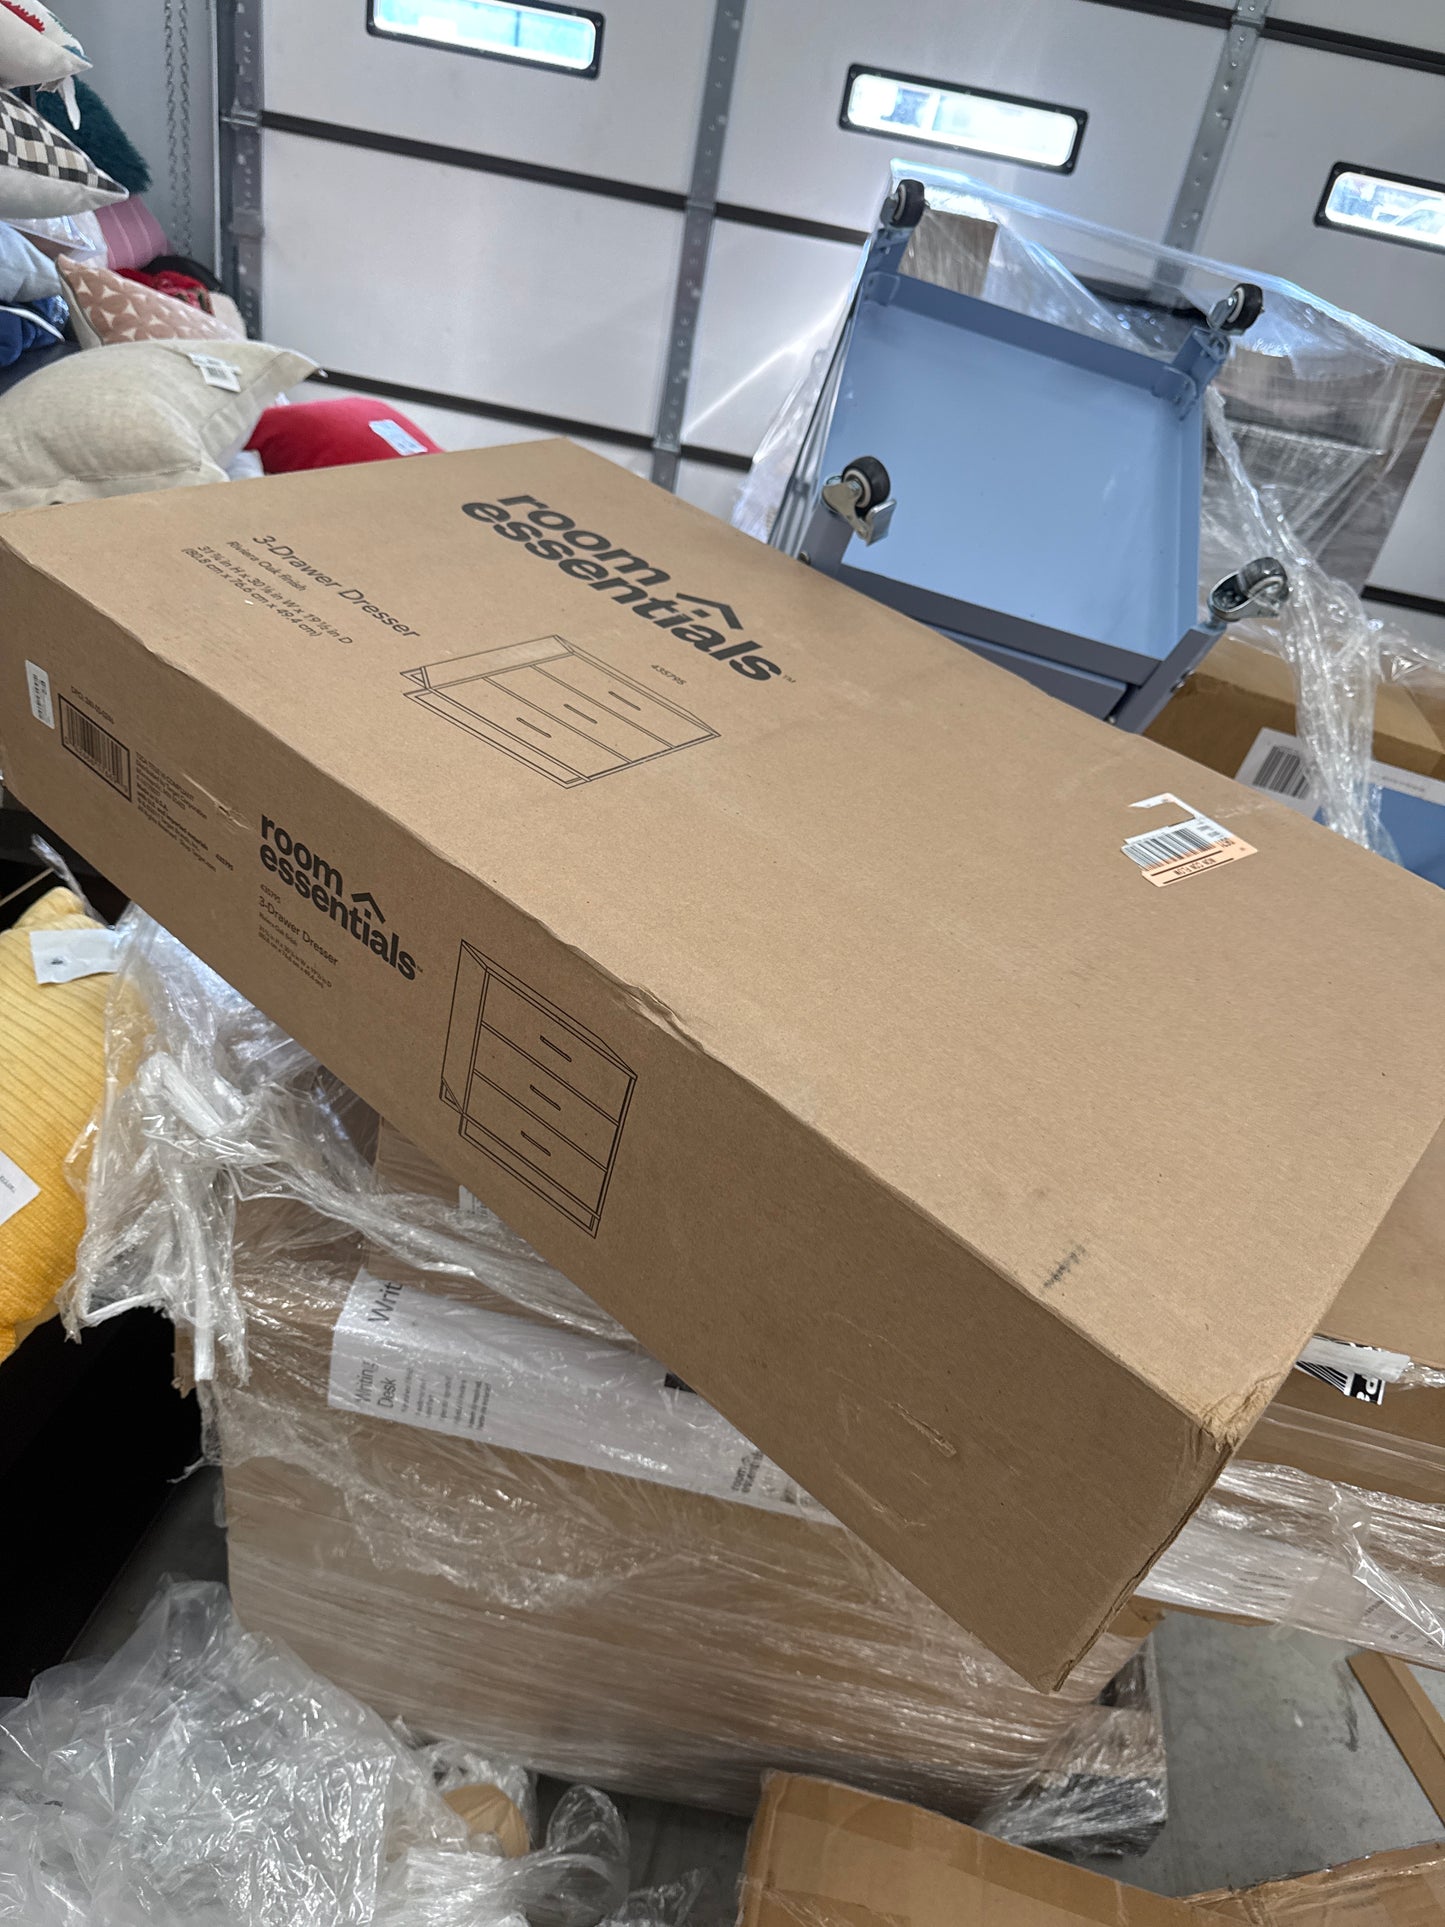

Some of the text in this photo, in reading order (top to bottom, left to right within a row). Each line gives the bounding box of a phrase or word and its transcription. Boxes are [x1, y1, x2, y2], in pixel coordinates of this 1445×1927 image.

[226, 541, 307, 591] Riviera Oak finish
[496, 494, 671, 587] room
[206, 564, 224, 574] cm
[251, 593, 269, 603] cm
[276, 608, 303, 624] 49.4
[298, 623, 323, 637] cm)
[252, 535, 421, 637] 3-Drawer Dresser
[282, 599, 300, 608] W
[338, 636, 353, 644] D
[461, 502, 783, 681] essentials
[261, 814, 343, 898] room
[258, 896, 339, 966] 3-Drawer Dresser
[260, 844, 416, 981] essentials
[355, 1361, 379, 1402] Writing
[376, 1377, 397, 1408] Desk
